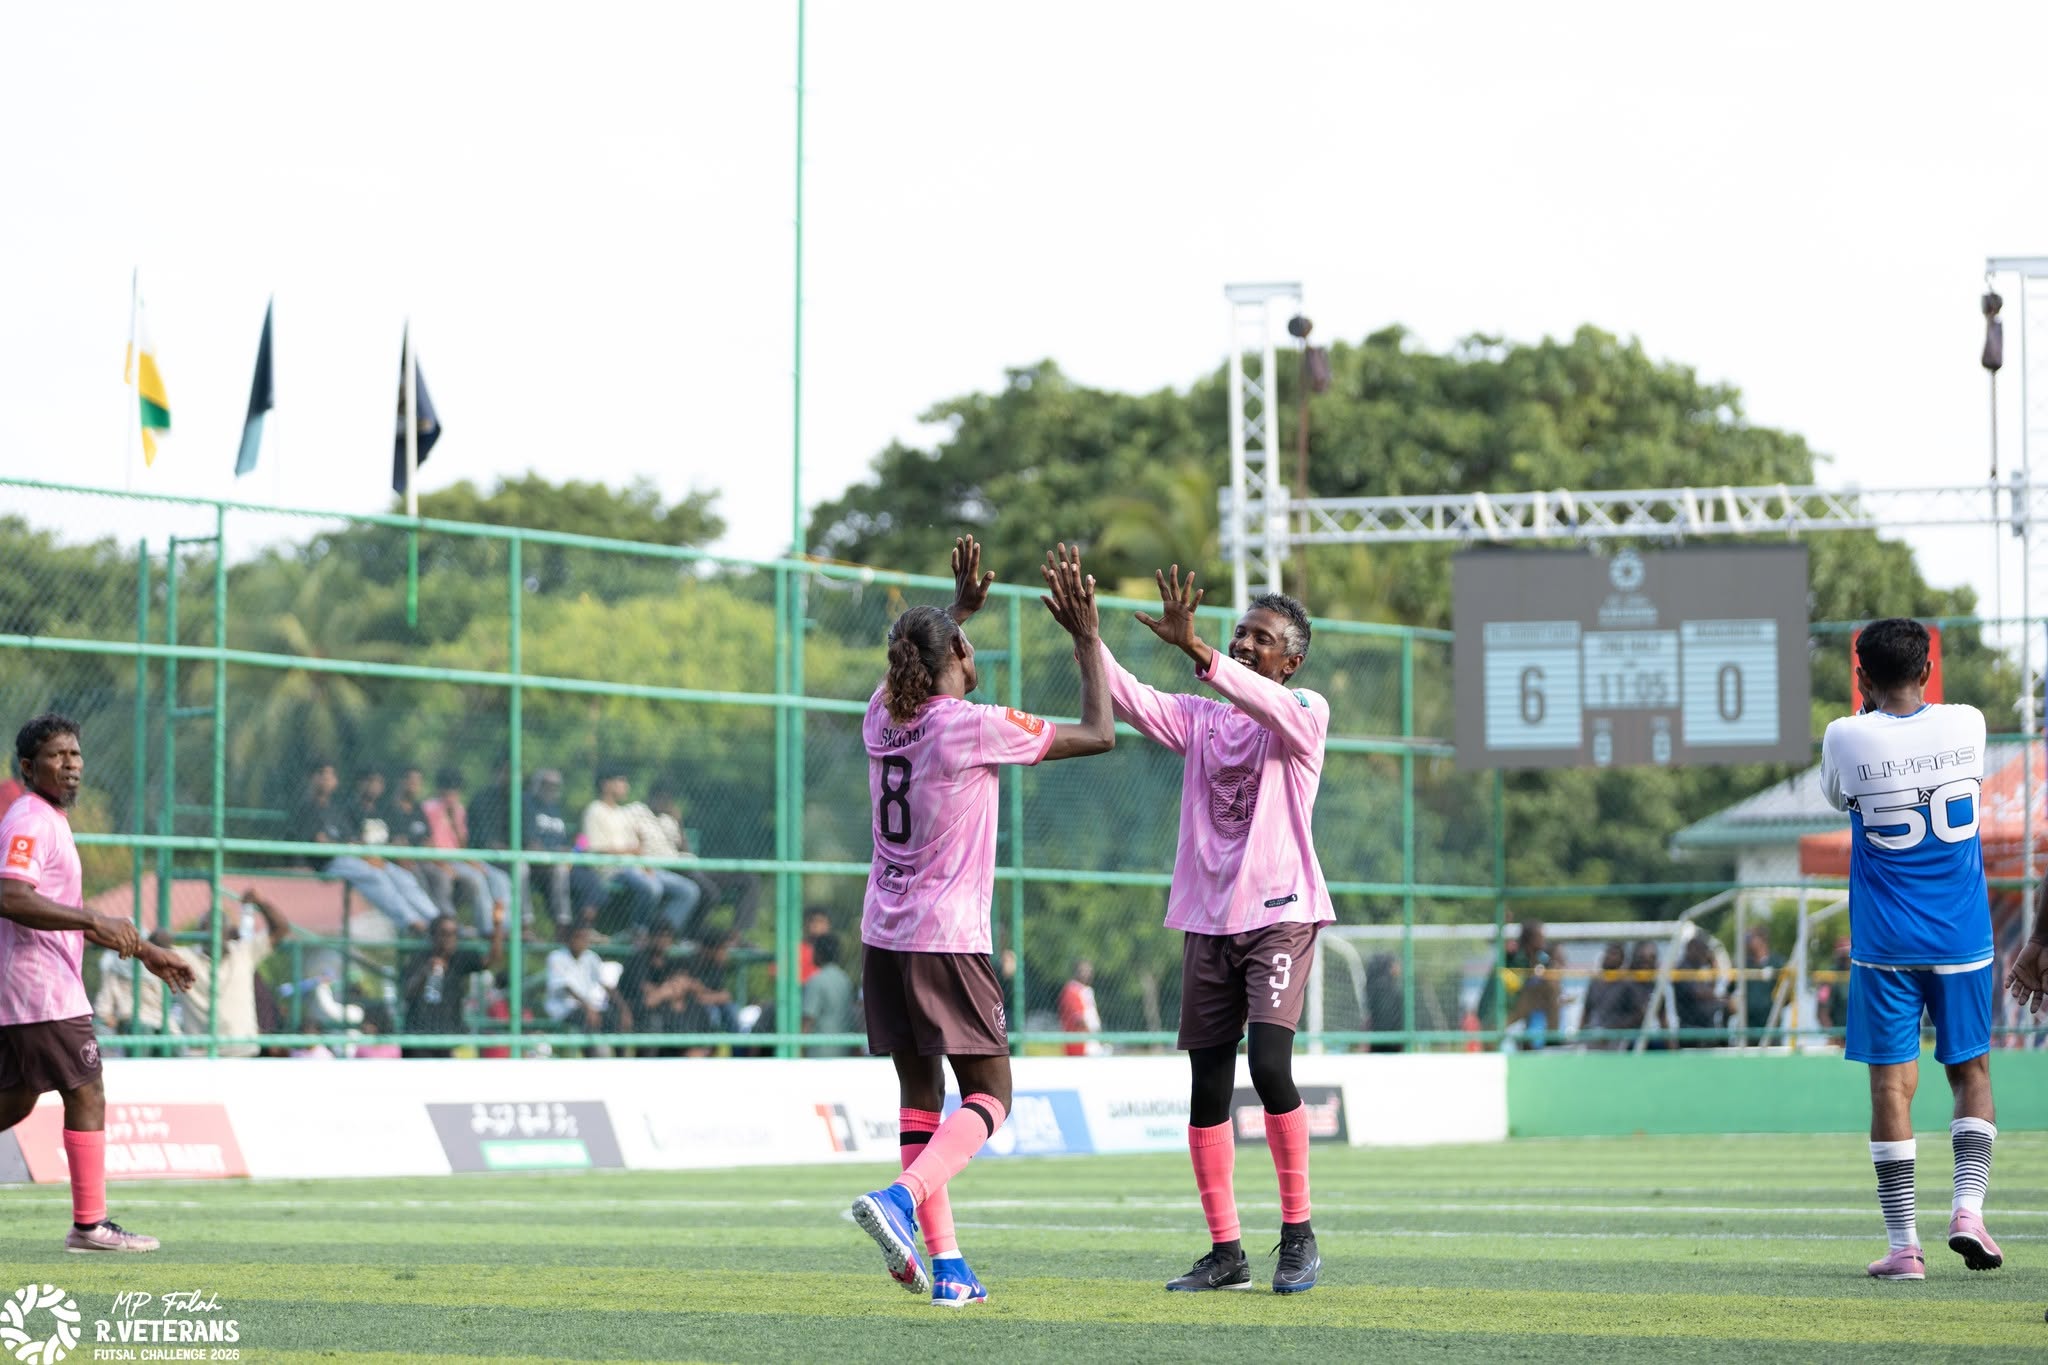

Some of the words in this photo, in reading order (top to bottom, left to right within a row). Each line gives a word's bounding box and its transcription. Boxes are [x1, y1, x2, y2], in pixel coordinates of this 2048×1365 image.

[1520, 665, 1545, 725] 6
[1718, 662, 1743, 722] 0
[880, 755, 912, 844] 8
[1855, 777, 1981, 850] 50
[1269, 953, 1292, 990] 3
